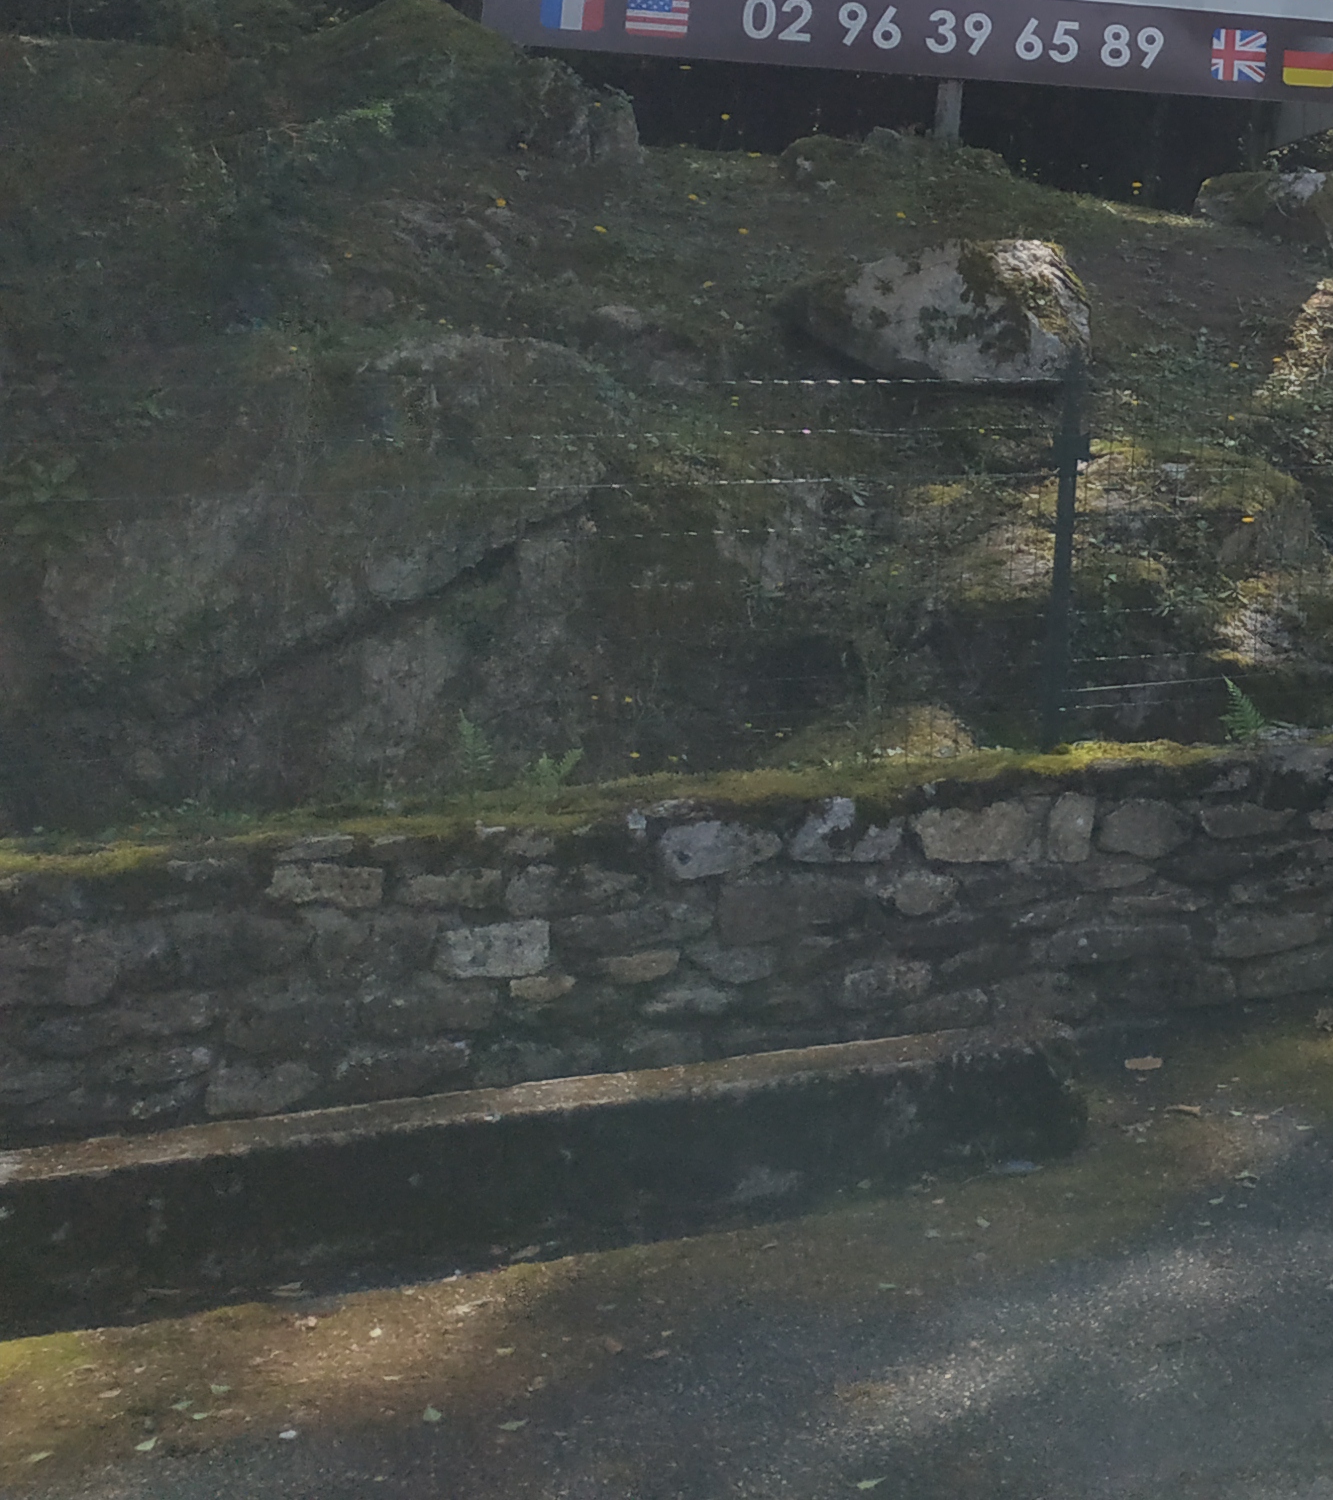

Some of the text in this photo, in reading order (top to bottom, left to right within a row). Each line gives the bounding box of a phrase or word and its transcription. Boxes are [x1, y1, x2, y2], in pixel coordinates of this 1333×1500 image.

[835, 1, 903, 50] 96
[924, 7, 994, 56] 39
[1013, 17, 1080, 62] 65
[1098, 23, 1166, 69] 89
